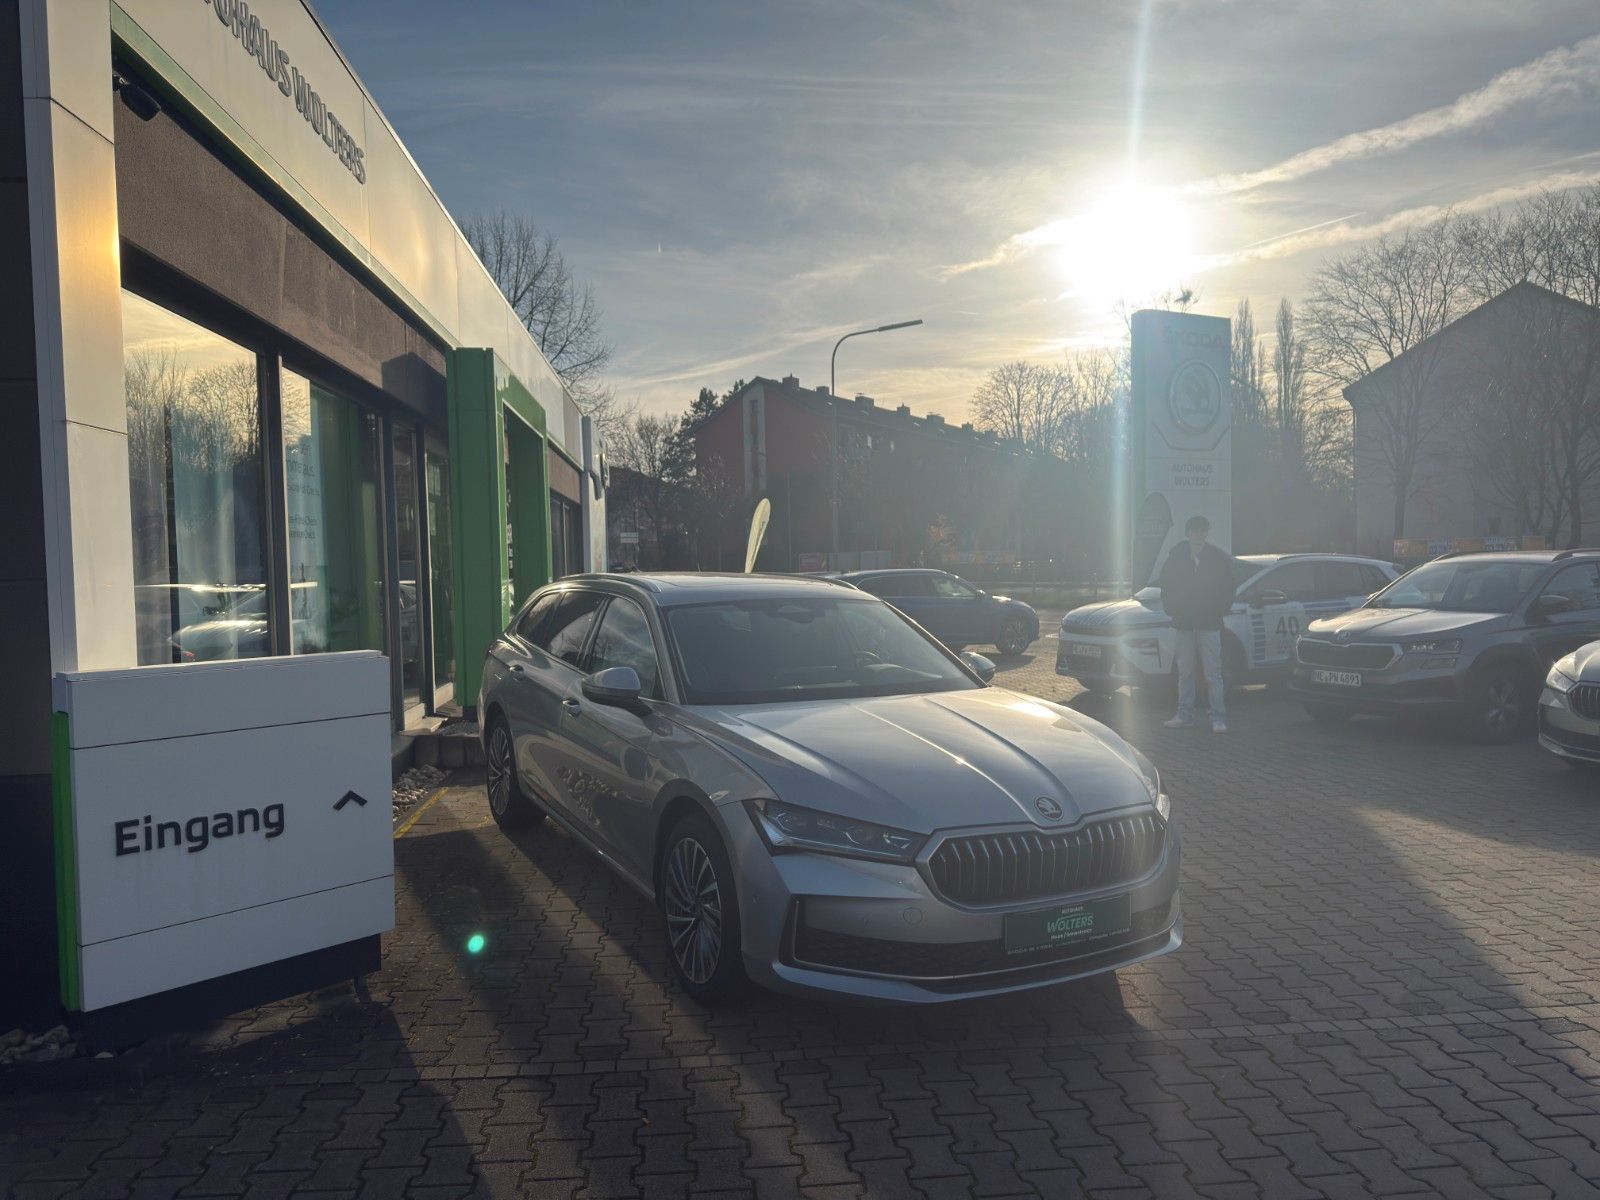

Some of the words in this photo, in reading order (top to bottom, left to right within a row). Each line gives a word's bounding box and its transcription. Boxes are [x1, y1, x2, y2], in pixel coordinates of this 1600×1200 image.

[291, 66, 366, 184] WOLTERS
[1171, 463, 1214, 474] AUTOHAUS
[1174, 476, 1210, 487] WOLTERS
[1275, 615, 1299, 638] 40
[114, 803, 285, 856] Eingang
[1047, 914, 1094, 933] WOLTERS
